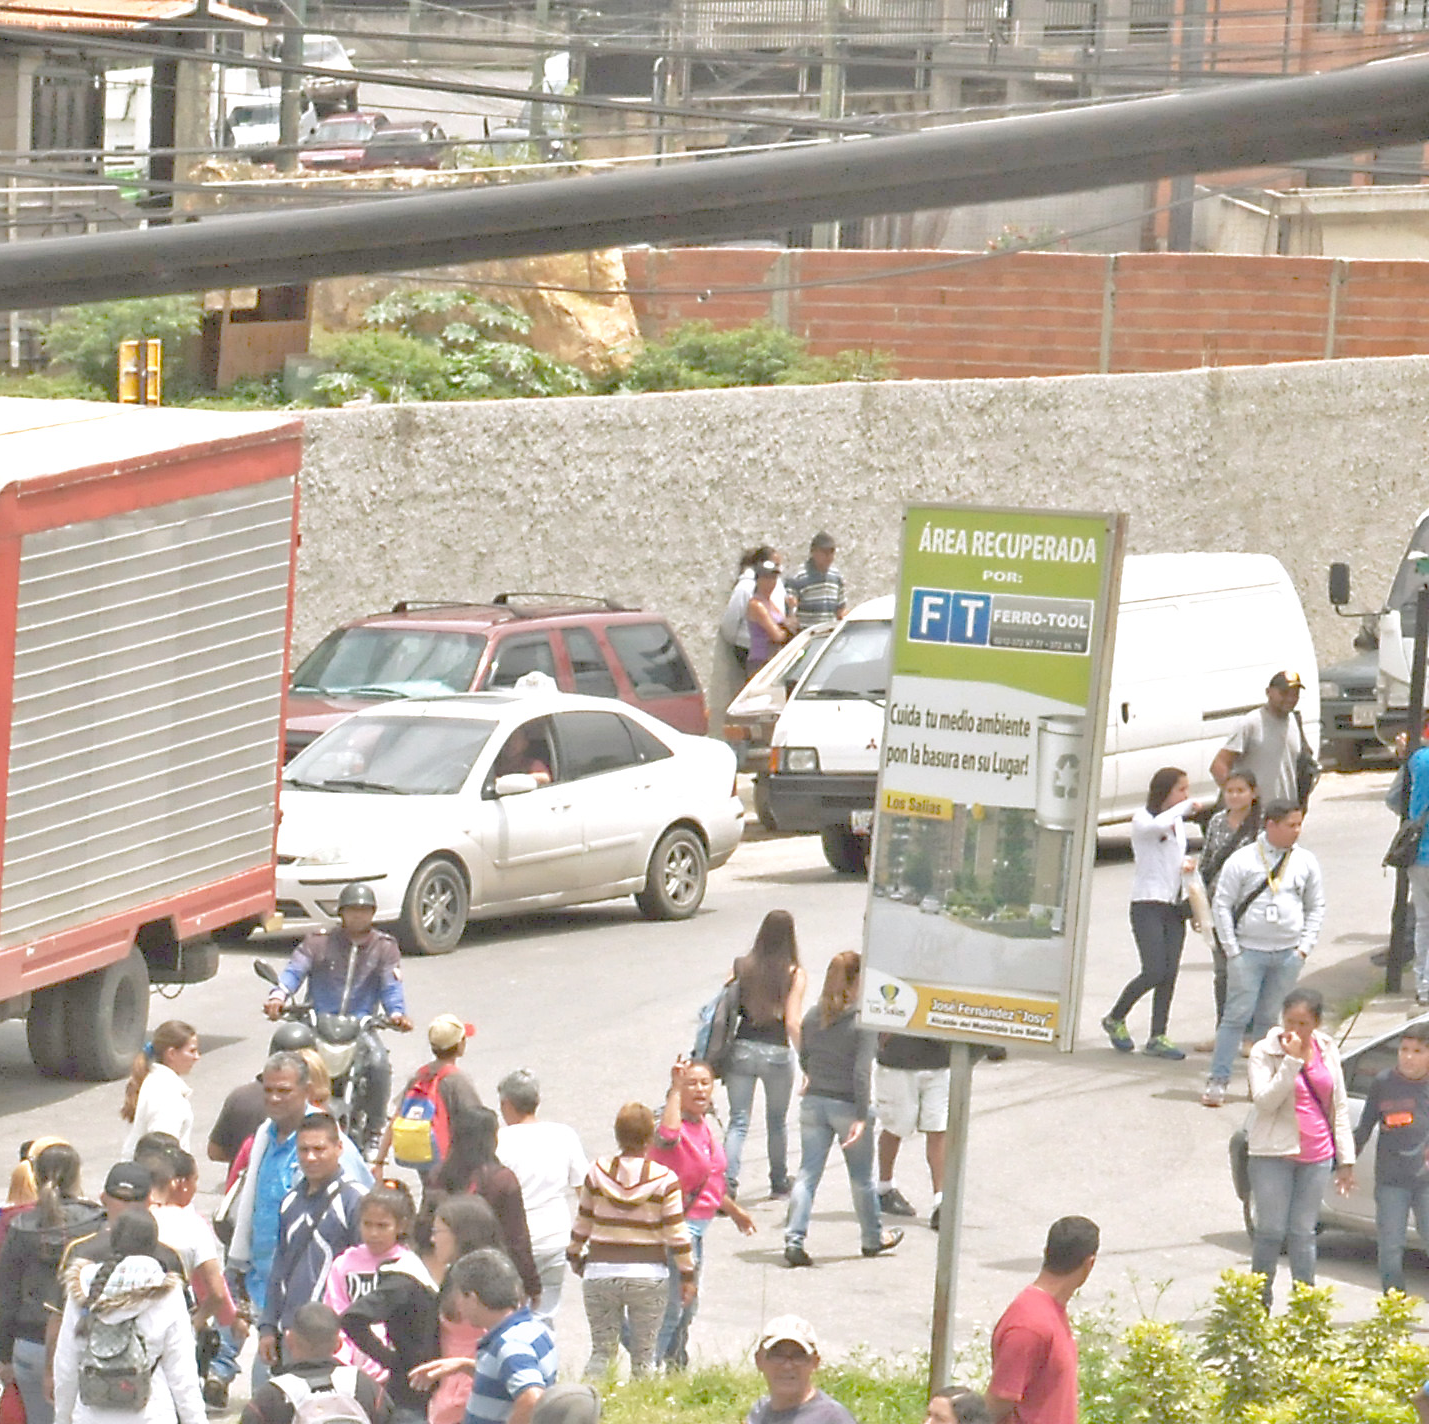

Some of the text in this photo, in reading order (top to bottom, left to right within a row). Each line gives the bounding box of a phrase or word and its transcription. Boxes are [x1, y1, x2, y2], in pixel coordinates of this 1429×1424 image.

[919, 521, 1097, 564] ÁREA RECUPERADA
[982, 570, 1023, 584] POR:
[993, 609, 1088, 629] FERRO-TOOL
[890, 703, 1031, 737] Cuida tu medio ambiente
[886, 742, 1029, 780] pon la basura en su Lugar!
[886, 794, 906, 811] Los
[931, 998, 957, 1014] José
[958, 1001, 1015, 1022] Fernández
